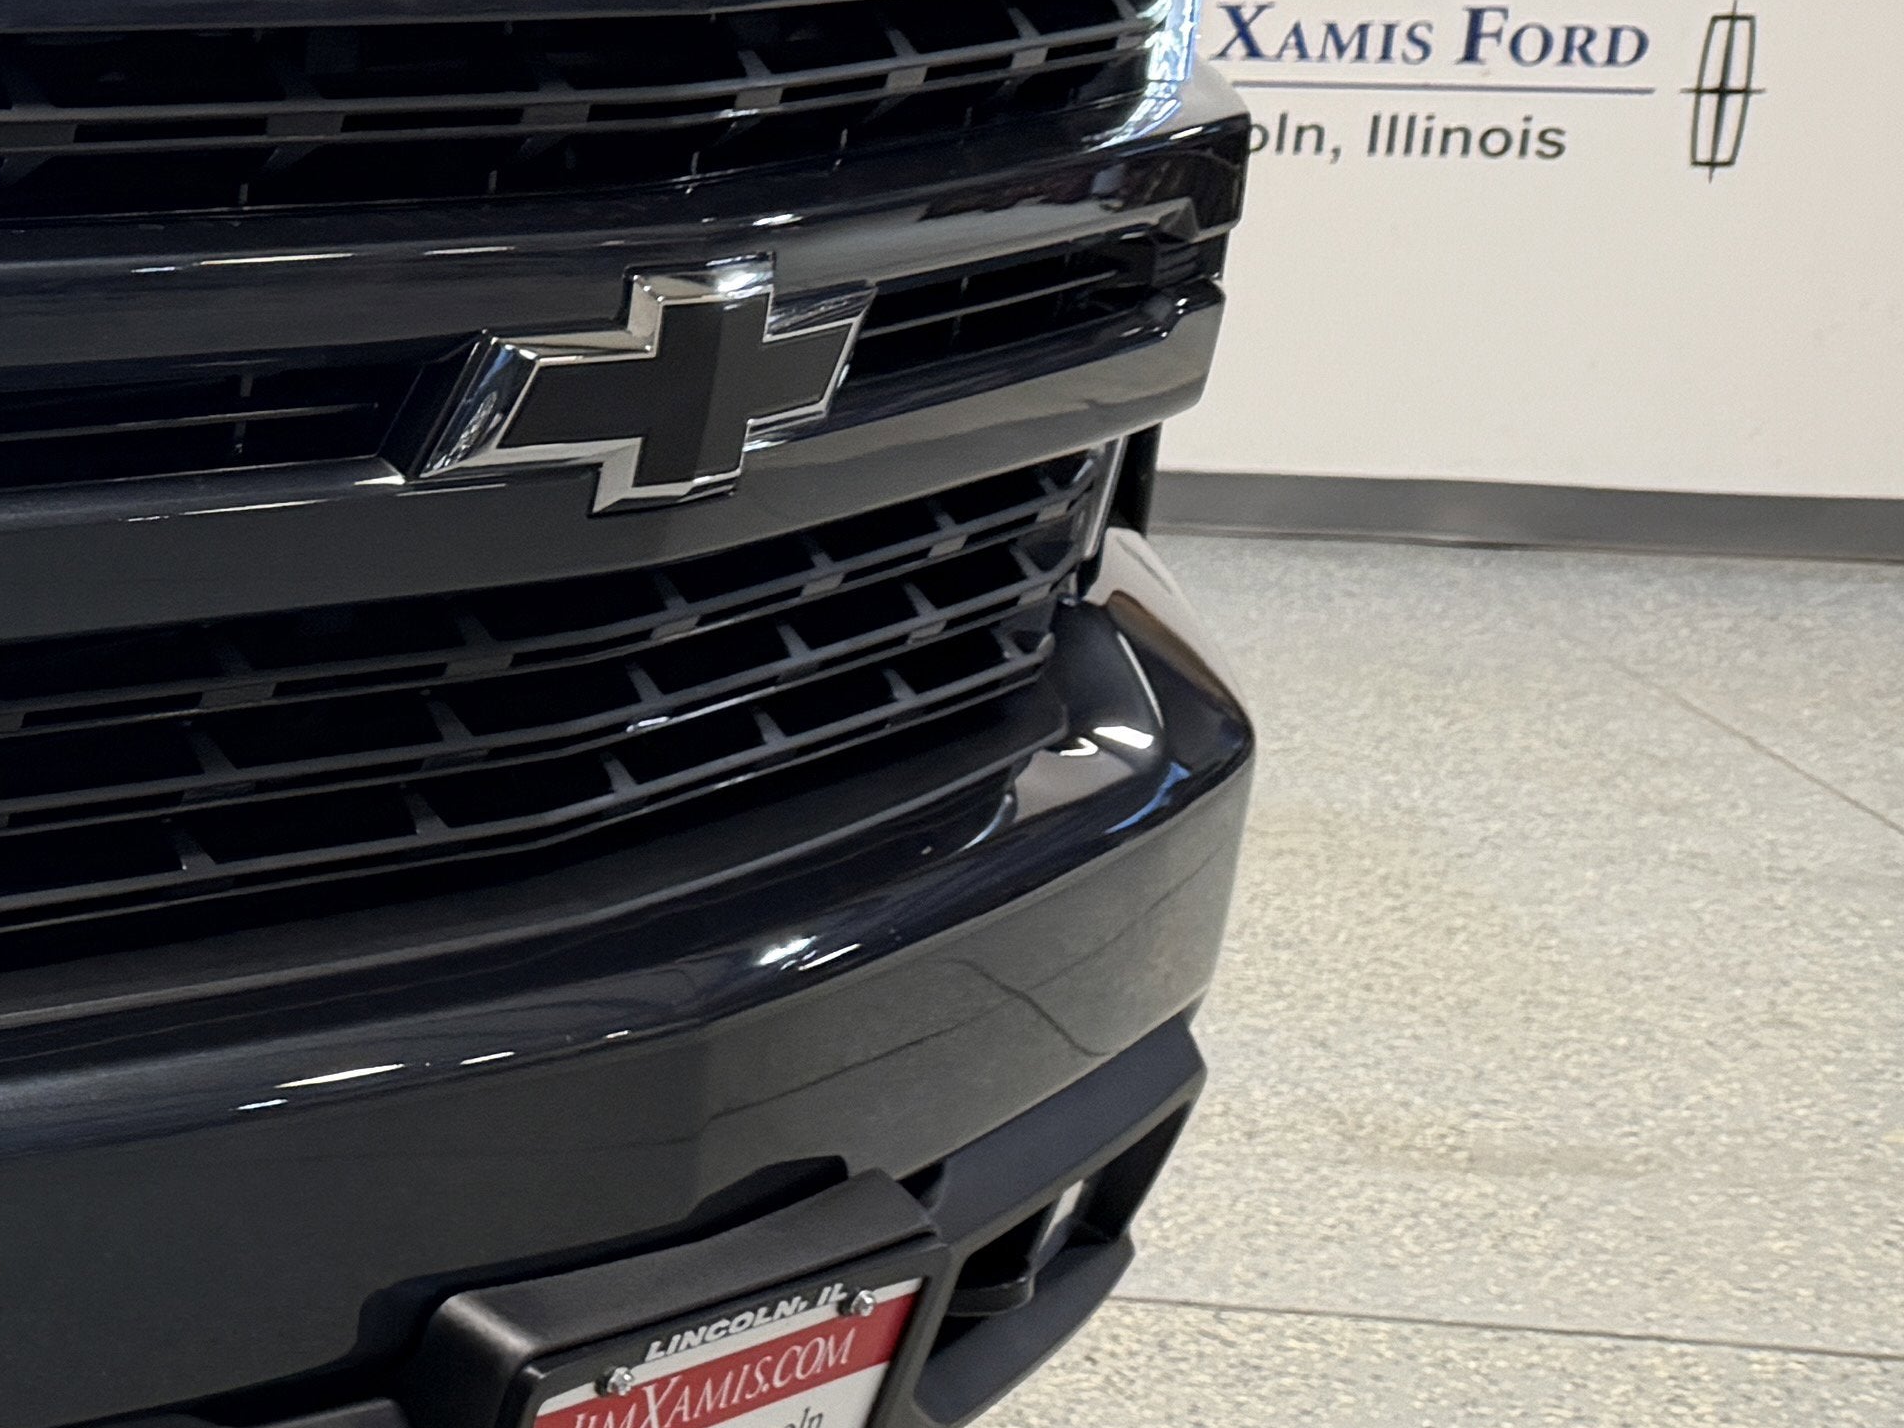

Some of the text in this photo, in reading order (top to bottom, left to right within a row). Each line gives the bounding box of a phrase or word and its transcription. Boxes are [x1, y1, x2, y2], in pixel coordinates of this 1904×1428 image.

[1210, 0, 1651, 69] XAMIS FORD
[1366, 113, 1568, 161] Illinois
[644, 1282, 849, 1363] LINCOLN, IL
